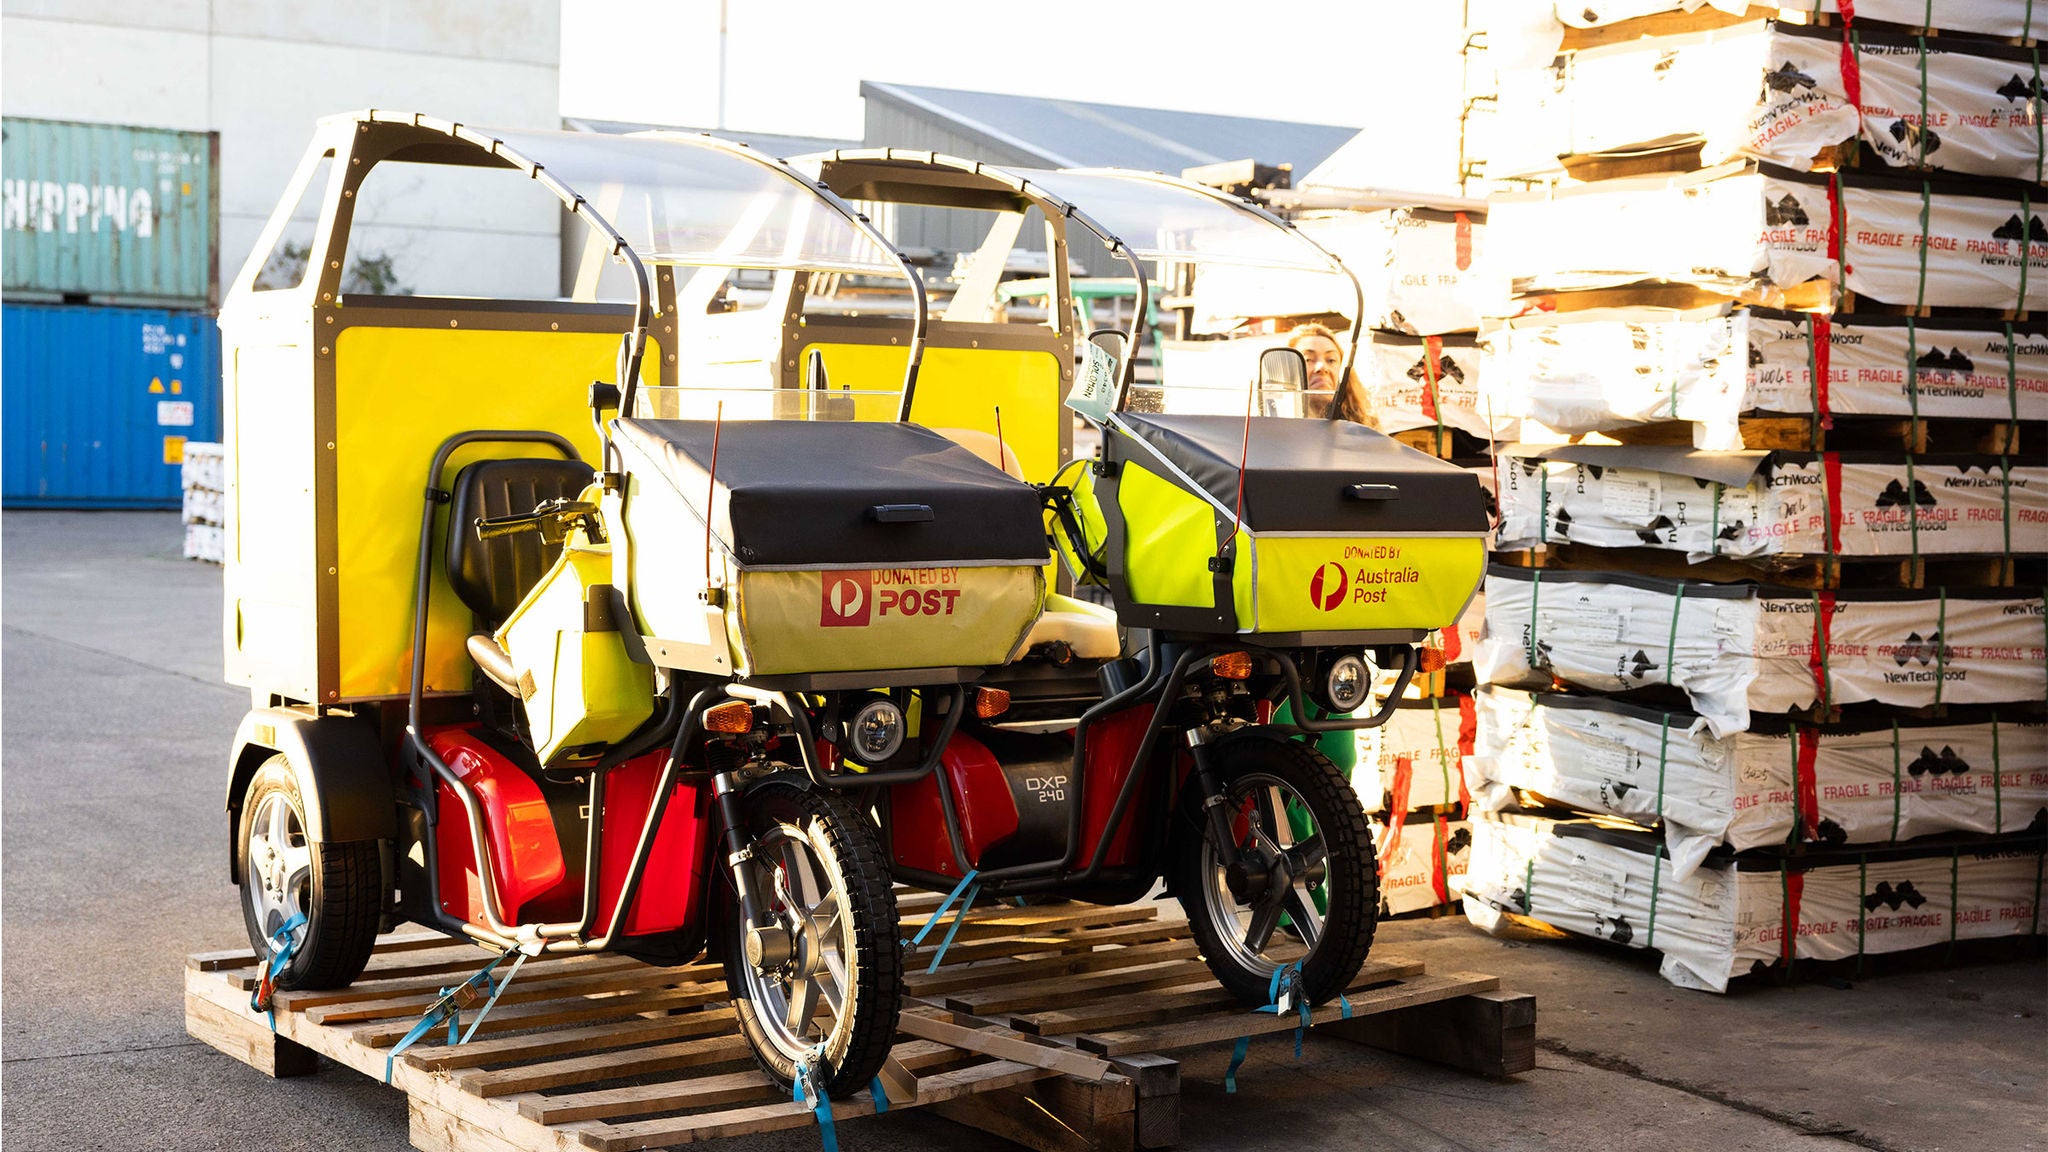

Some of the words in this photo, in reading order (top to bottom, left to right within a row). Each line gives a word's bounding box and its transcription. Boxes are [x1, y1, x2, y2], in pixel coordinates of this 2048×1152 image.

[1857, 230, 1904, 248] FRAGILE
[1858, 368, 1903, 384] FRAGILE
[1344, 546, 1387, 559] DONATED
[1388, 546, 1401, 560] BY
[872, 568, 938, 585] DONATED
[941, 567, 959, 584] BY
[1355, 567, 1419, 585] Australia
[878, 589, 961, 617] POST
[1354, 588, 1388, 604] Post
[1982, 647, 2023, 661] FRAGILE
[1026, 775, 1067, 791] DXP
[1039, 789, 1065, 802] 240
[1824, 783, 1870, 800] FRAGILE
